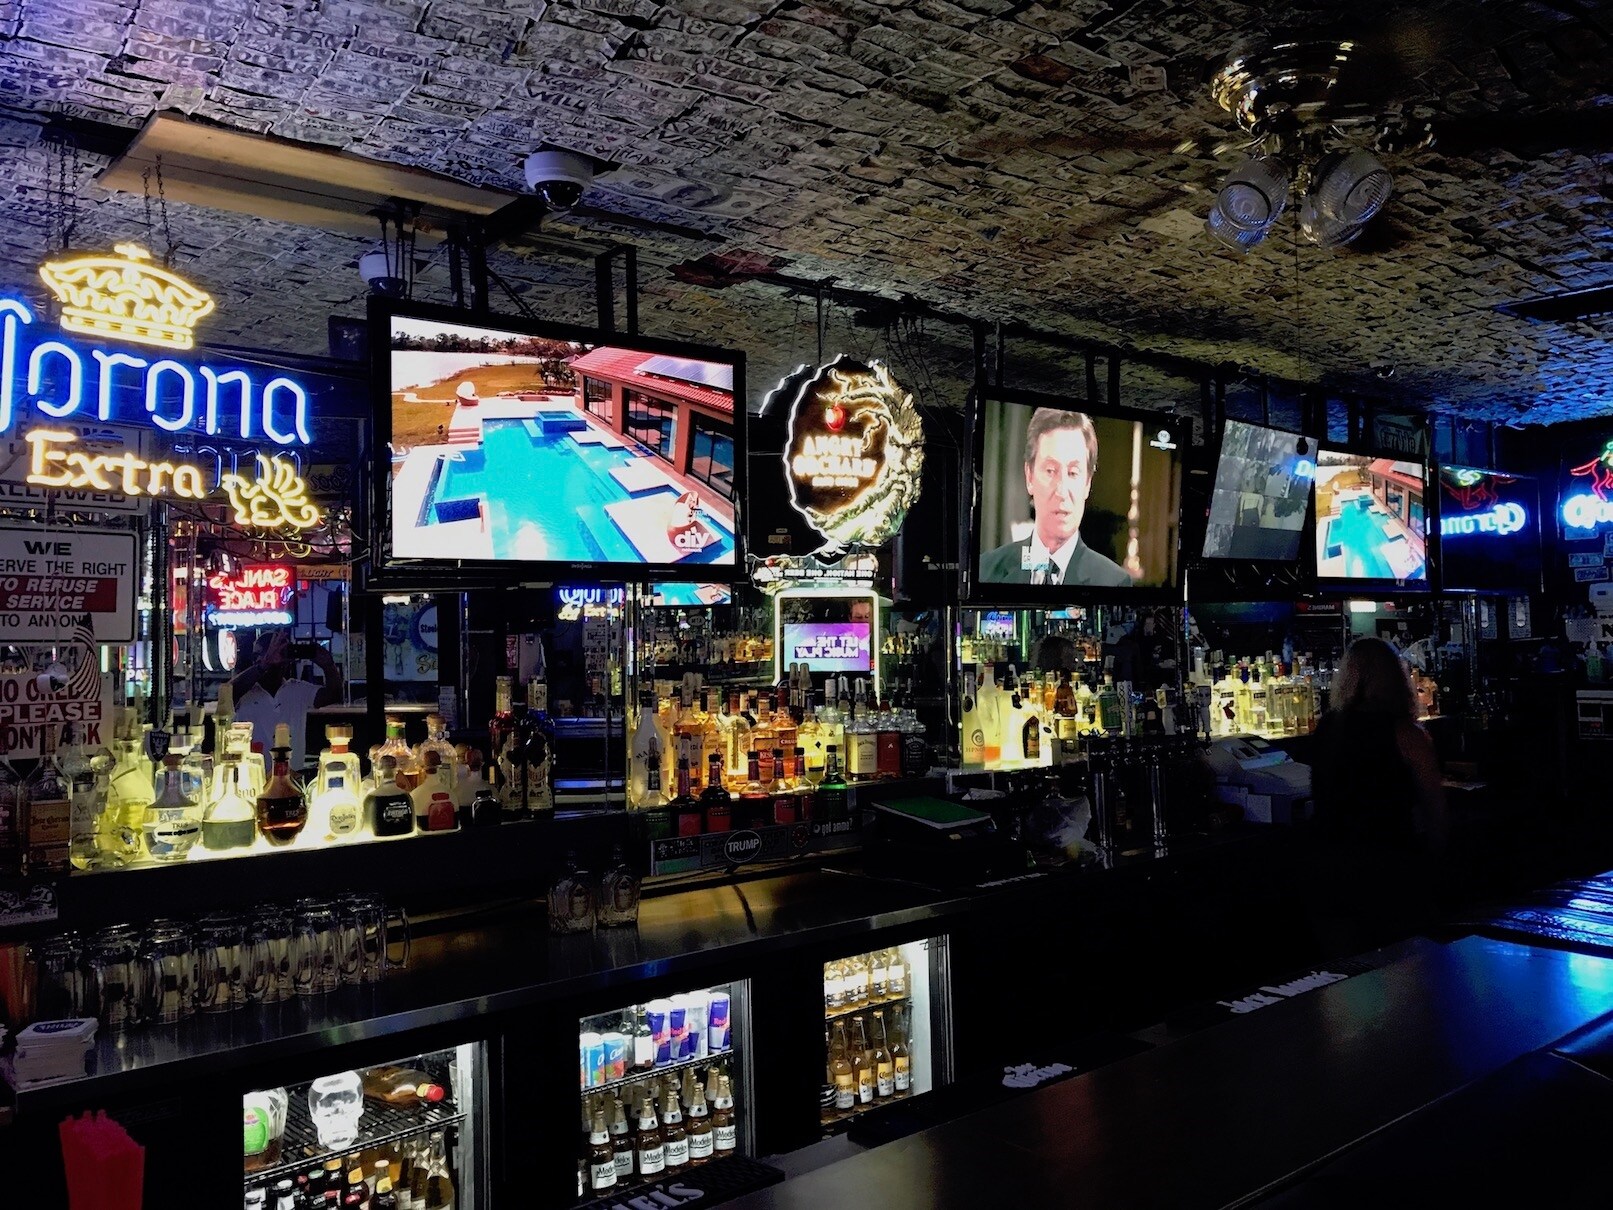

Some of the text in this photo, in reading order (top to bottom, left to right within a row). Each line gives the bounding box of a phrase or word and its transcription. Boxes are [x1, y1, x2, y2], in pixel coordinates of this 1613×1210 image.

[25, 430, 207, 500] Extra
[674, 526, 711, 549] diy
[24, 541, 72, 556] WE
[46, 560, 74, 574] THE
[82, 562, 127, 576] RIGHT
[26, 577, 99, 593] REFUSE
[1, 614, 82, 628] TO ANYON
[0, 702, 100, 723] PLEASE
[59, 723, 101, 747] AK
[728, 838, 760, 853] TRUMP
